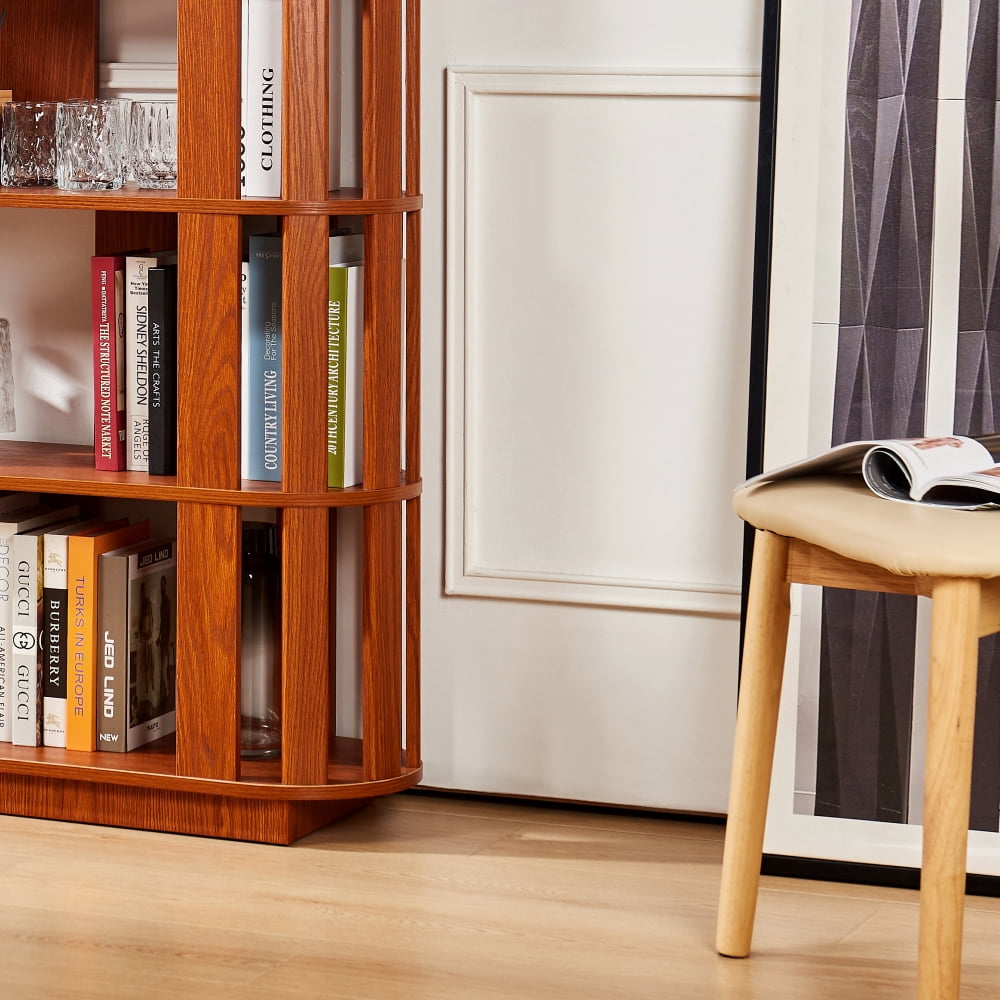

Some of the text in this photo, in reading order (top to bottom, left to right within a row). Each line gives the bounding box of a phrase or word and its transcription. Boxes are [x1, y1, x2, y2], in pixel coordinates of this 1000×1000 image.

[261, 68, 274, 171] CLOTHING
[100, 323, 110, 341] THE
[136, 305, 148, 405] SIDNEY SHELDON
[152, 323, 160, 408] ARTS THE CRAFTS
[100, 341, 111, 398] STRUCTURED
[101, 399, 111, 424] NOTE
[133, 421, 142, 460] ANGELS
[264, 370, 278, 471] COUNTRY LIVING
[17, 560, 30, 617] GUCCI
[49, 599, 60, 687] BURBERRY
[74, 576, 85, 717] TURKS IN EUROPE
[103, 631, 115, 718] JED LIND
[17, 665, 30, 721] GUCCI
[99, 733, 119, 742] NEW
